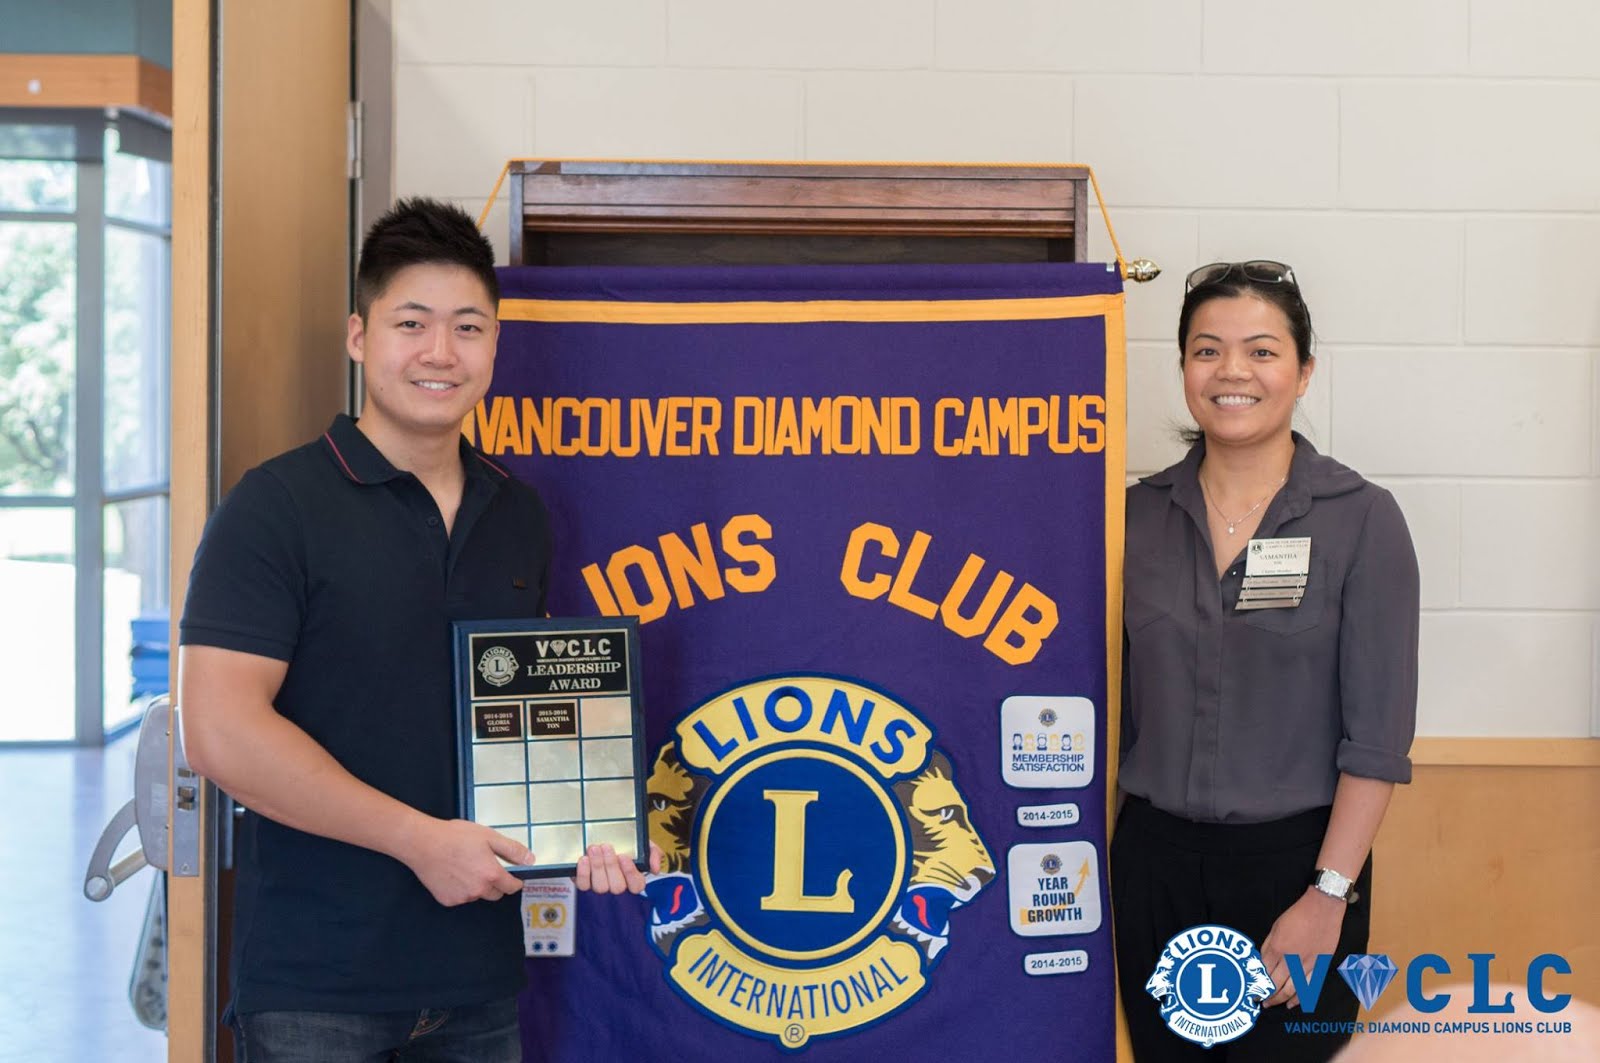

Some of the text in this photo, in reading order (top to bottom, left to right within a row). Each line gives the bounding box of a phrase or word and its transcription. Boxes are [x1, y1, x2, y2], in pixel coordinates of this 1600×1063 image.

[475, 395, 1105, 456] VANCOUVER DIAMOND CAMPUS
[546, 514, 1059, 666] IONS CLUB
[527, 661, 622, 677] LEADERSHIP
[548, 678, 601, 691] AWARD
[483, 712, 513, 720] 2014-2015
[536, 715, 570, 723] SAMANTHA
[692, 686, 916, 763] LIONS
[1012, 753, 1084, 763] MEMBERSHIP
[1011, 762, 1085, 773] SATISFACTION
[1022, 809, 1073, 821] 2014-2015
[761, 789, 854, 913] L
[1037, 876, 1068, 891] YEAR
[1032, 892, 1075, 907] ROUND
[1027, 907, 1082, 923] GROWTH
[1030, 956, 1082, 969] 2014-2015
[688, 947, 908, 1020] INTERNATIONAL
